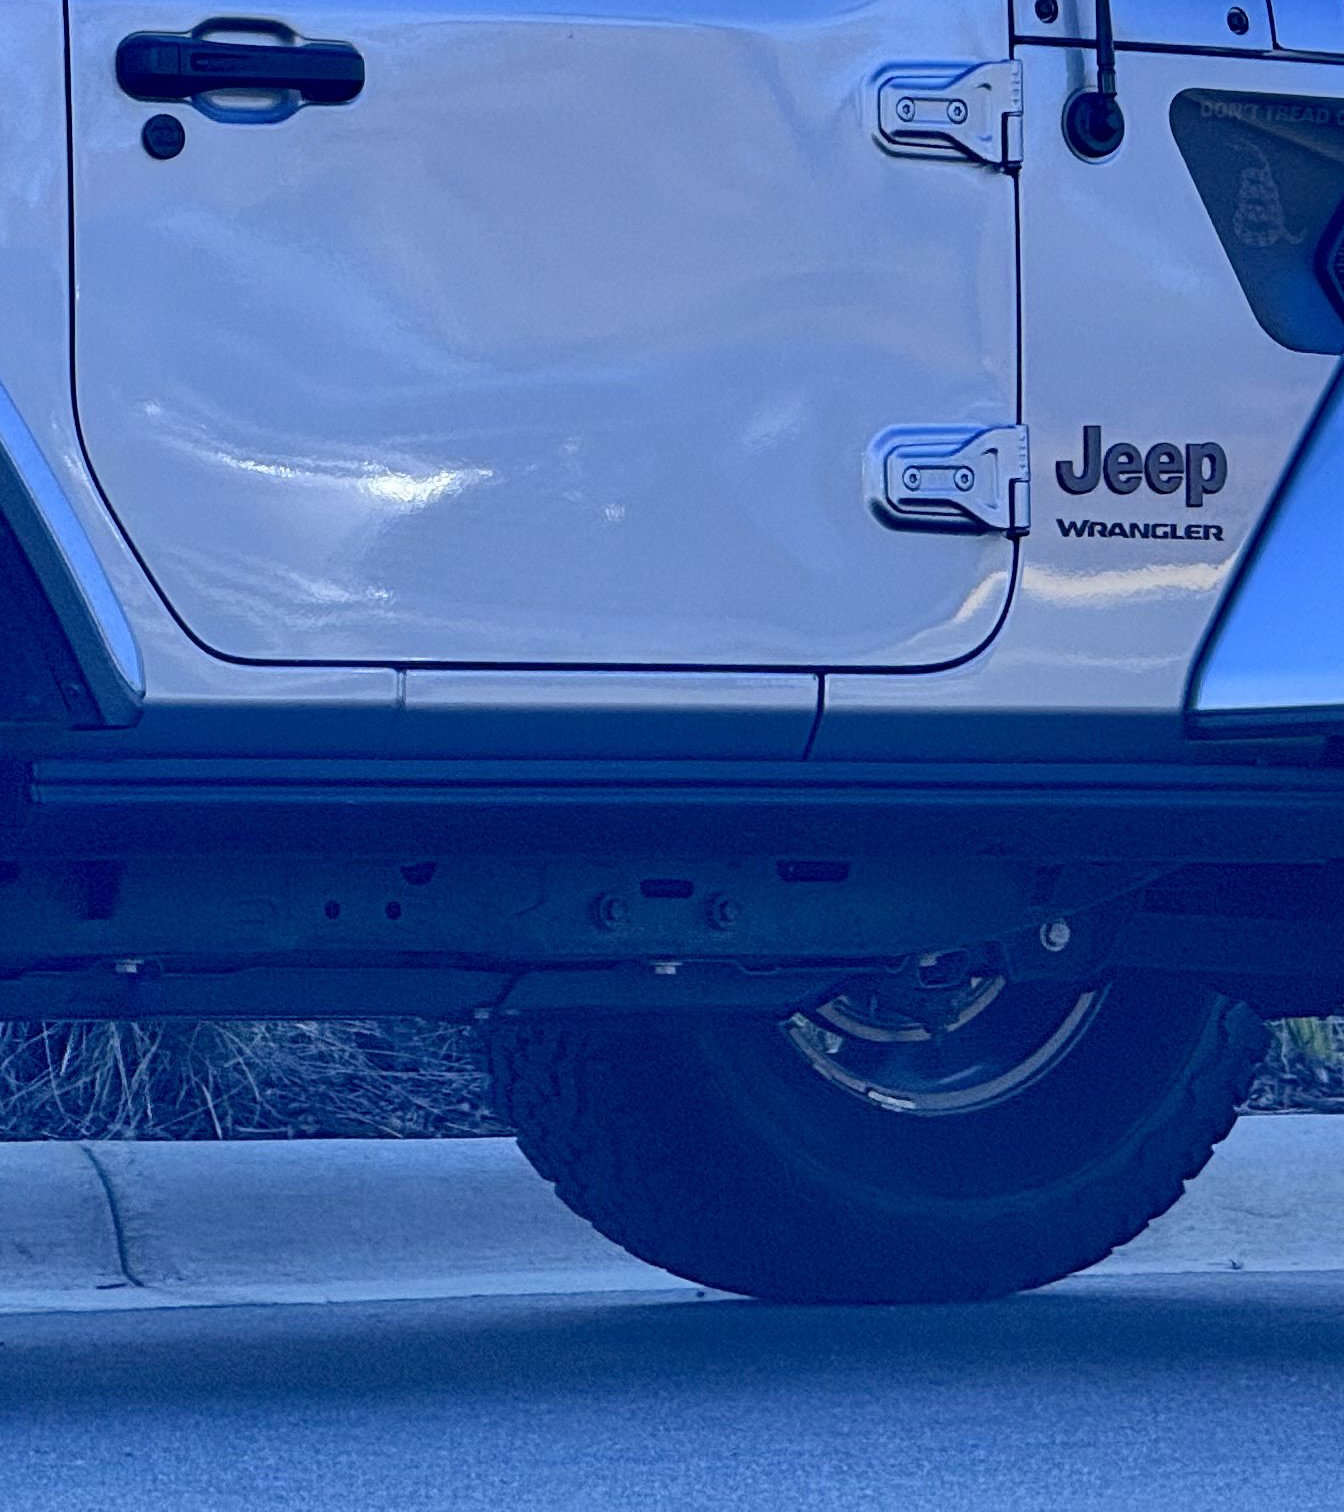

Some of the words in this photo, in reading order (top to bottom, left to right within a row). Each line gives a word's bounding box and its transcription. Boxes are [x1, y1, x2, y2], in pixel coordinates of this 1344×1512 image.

[1265, 103, 1331, 125] TREAD
[1055, 425, 1228, 508] Jeep
[1056, 518, 1225, 542] WRANGLER
